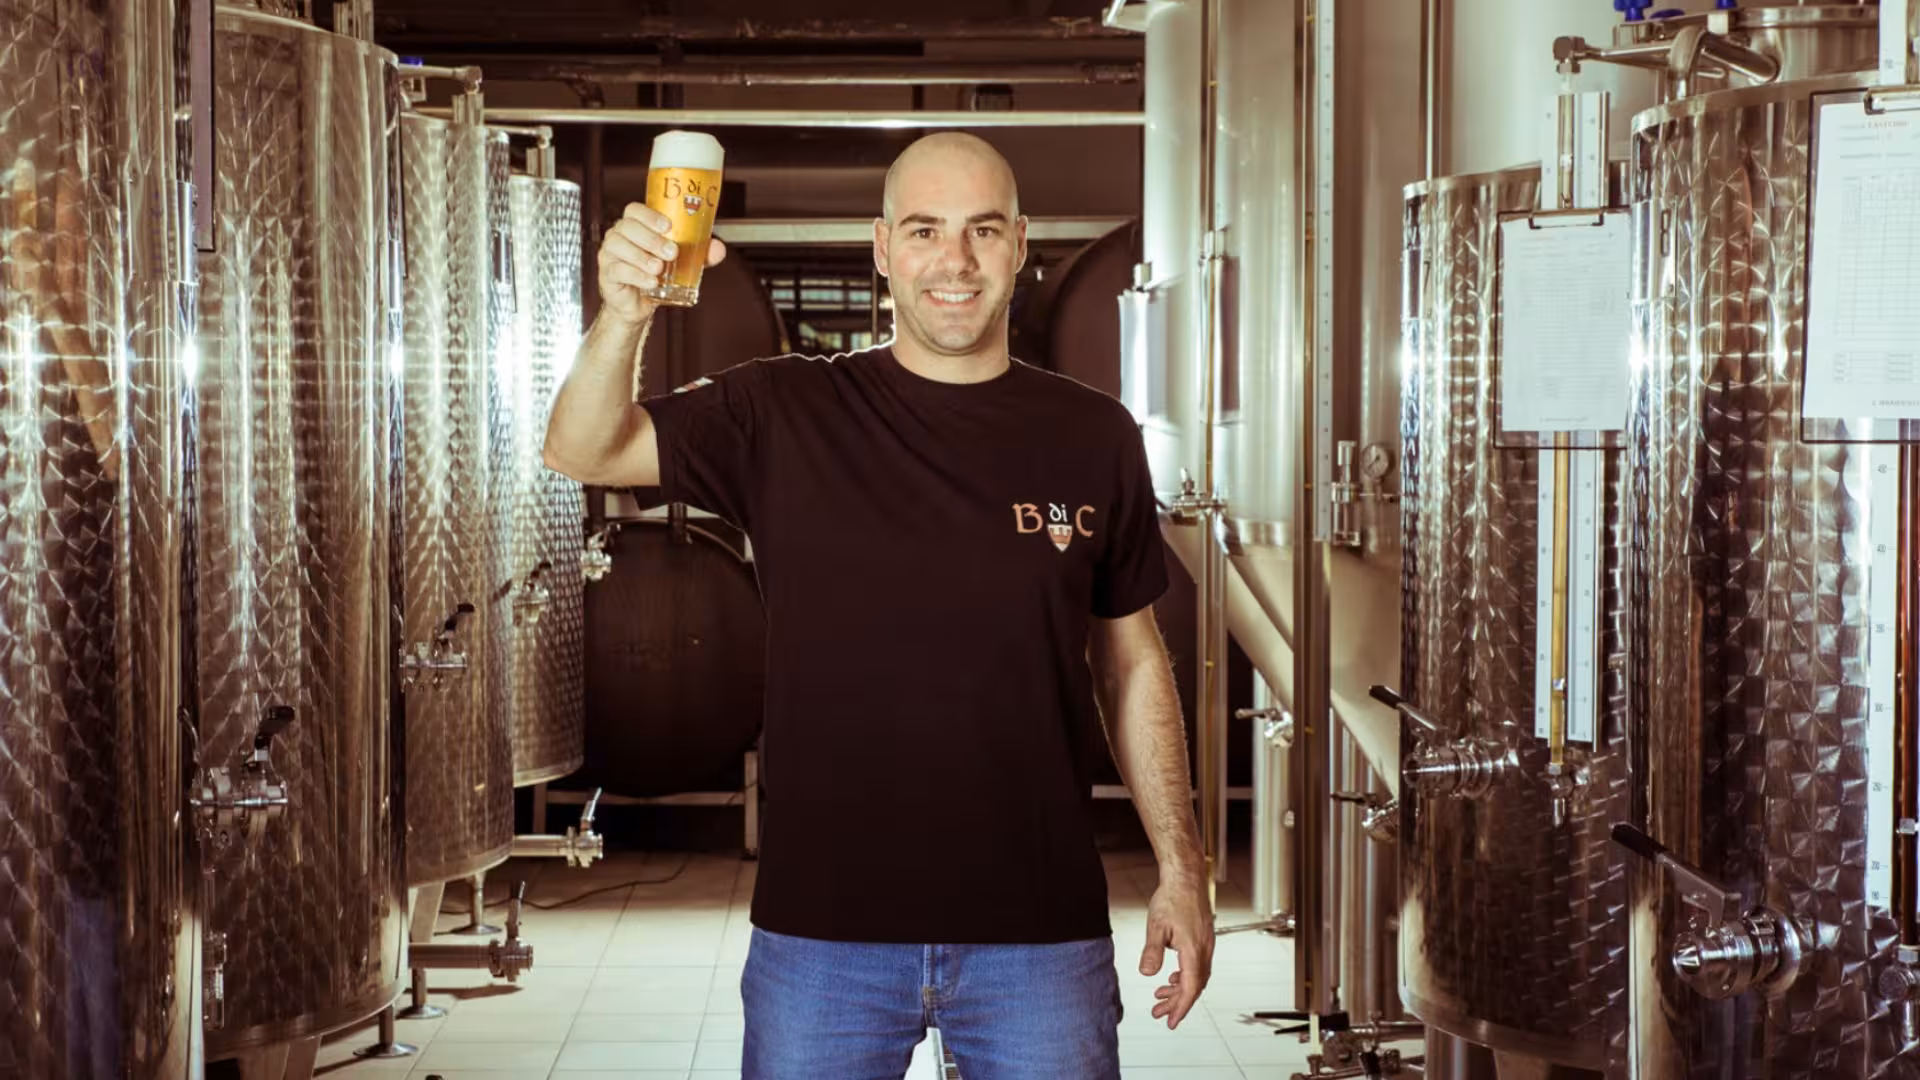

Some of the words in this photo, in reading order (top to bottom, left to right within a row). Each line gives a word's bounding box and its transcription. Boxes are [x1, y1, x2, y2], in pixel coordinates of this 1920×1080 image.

[663, 177, 682, 200] B
[687, 178, 702, 195] di
[706, 184, 718, 208] C
[1012, 503, 1043, 533] B
[1048, 502, 1068, 523] di
[1075, 504, 1096, 537] C
